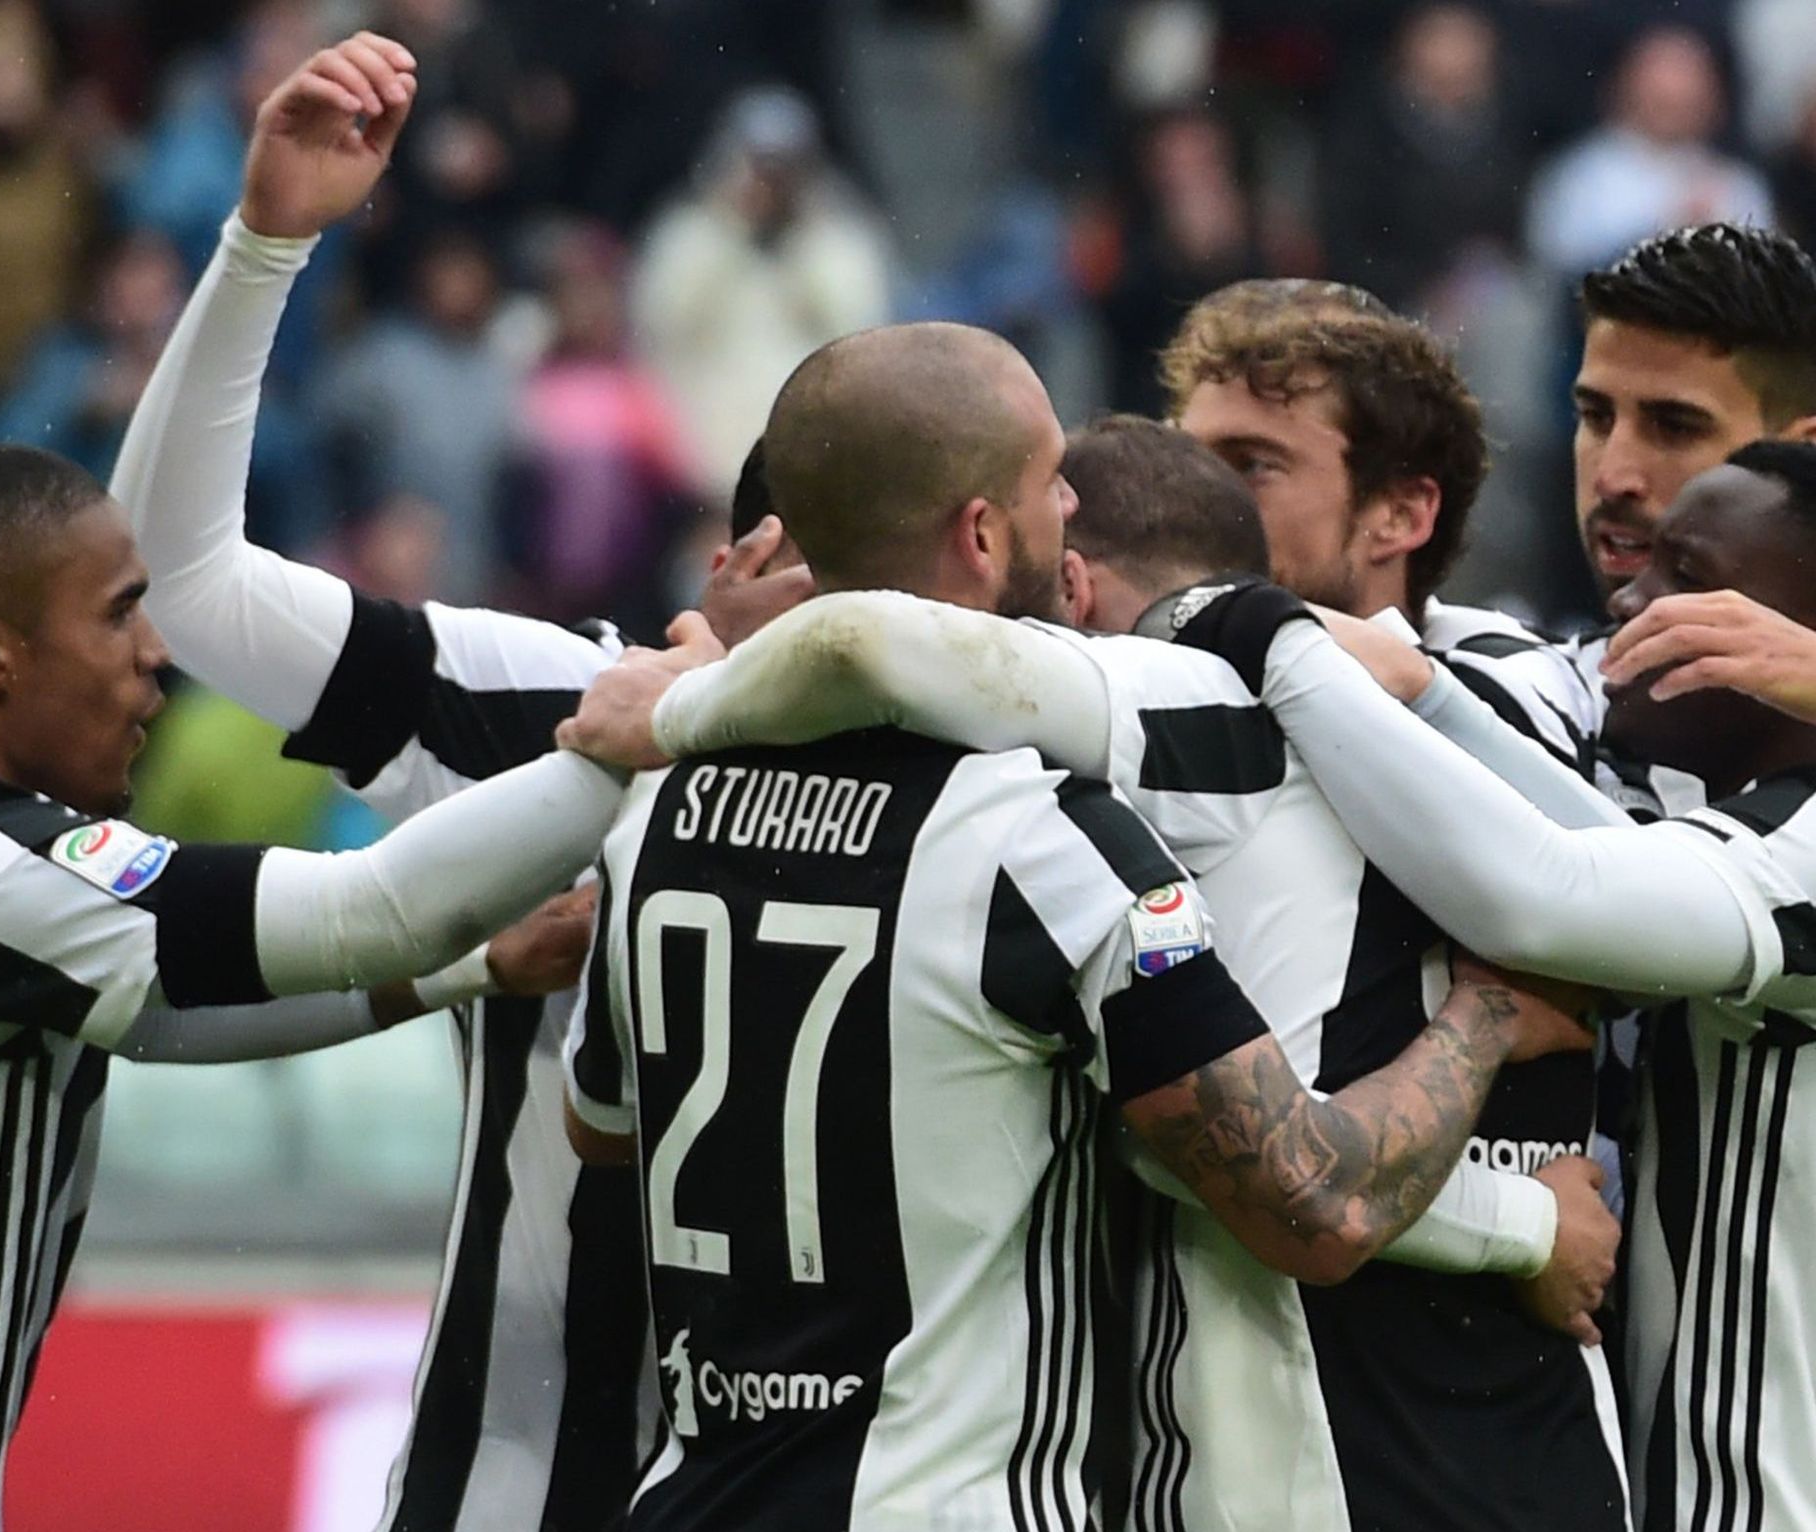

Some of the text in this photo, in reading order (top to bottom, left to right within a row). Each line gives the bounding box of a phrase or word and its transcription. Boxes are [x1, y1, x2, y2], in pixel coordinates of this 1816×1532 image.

[673, 764, 893, 857] STURARO
[636, 888, 881, 1285] 27
[698, 1359, 865, 1423] Cygame
